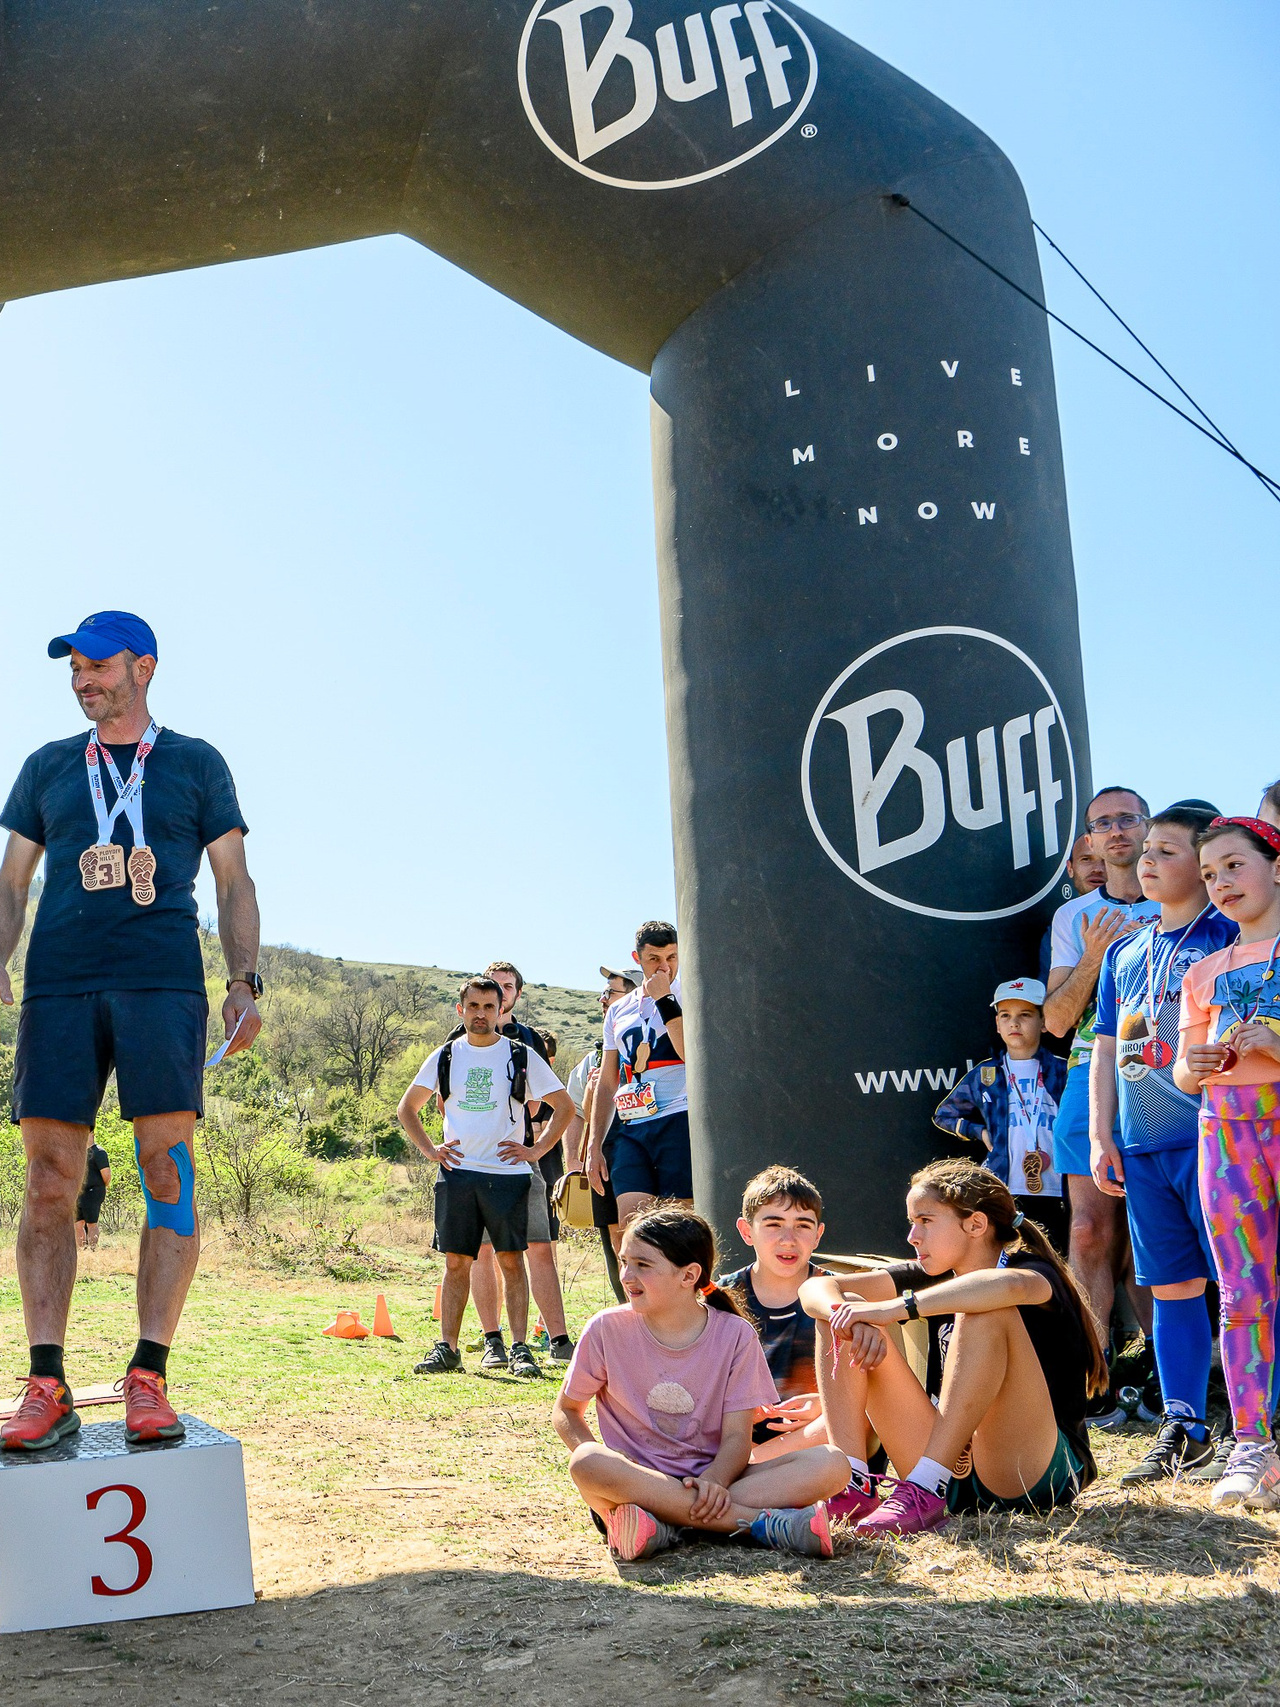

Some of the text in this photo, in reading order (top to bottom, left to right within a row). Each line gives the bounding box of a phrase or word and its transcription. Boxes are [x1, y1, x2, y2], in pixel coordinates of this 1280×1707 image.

[785, 360, 1022, 398] LIVE
[793, 430, 1031, 465] MORE
[858, 501, 996, 525] NOW
[99, 864, 114, 886] 3
[614, 1095, 638, 1110] 2354
[86, 1484, 154, 1597] 3
